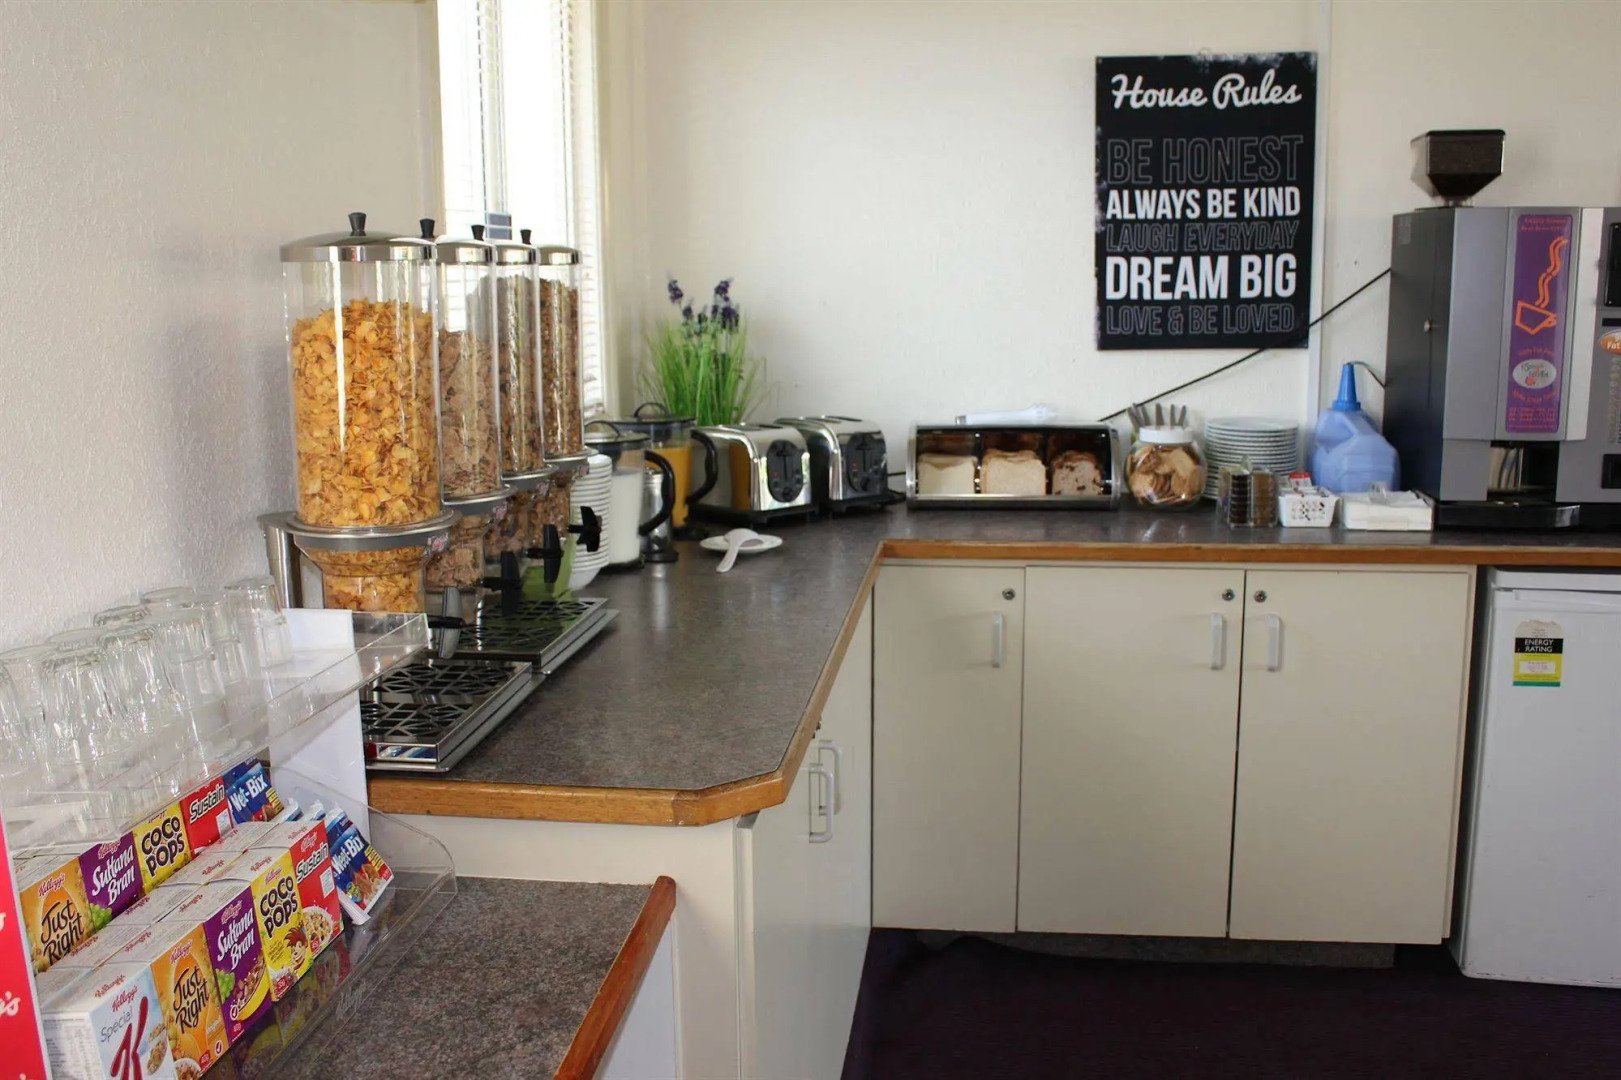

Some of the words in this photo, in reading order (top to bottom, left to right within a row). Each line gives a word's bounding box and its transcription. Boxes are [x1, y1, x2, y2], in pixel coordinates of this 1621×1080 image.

[1111, 74, 1208, 109] House
[1213, 69, 1302, 110] Rules
[1107, 138, 1153, 184] BE
[1162, 135, 1303, 184] HONEST
[1106, 188, 1200, 220] ALWAYS
[1207, 188, 1237, 218] BE
[1244, 186, 1300, 218] KIND
[1106, 223, 1178, 252] LAUGH
[1184, 220, 1299, 250] EVERYDAY
[1106, 255, 1229, 300] DREAM
[1240, 253, 1296, 298] BIG
[1106, 305, 1162, 335] LOVE
[1168, 305, 1183, 335] &
[1189, 304, 1218, 334] BE
[1223, 303, 1295, 333] LOVED
[190, 784, 225, 824] Sustain
[141, 816, 181, 855] COCO
[145, 832, 185, 878] POPS
[331, 834, 365, 875] Weet-Bix
[92, 845, 134, 896] Sultana
[297, 842, 329, 884] Sustain
[107, 865, 136, 906] Bran
[260, 876, 294, 917] COCO
[41, 899, 75, 944] Just
[217, 907, 254, 962] Sultana
[263, 892, 298, 940] POPS
[43, 912, 84, 966] Right
[230, 928, 255, 970] Bran
[112, 985, 138, 1013] Kellogg's
[173, 966, 200, 1011] Just
[176, 978, 209, 1034] Right
[100, 1005, 133, 1043] Special
[110, 996, 149, 1080] K
